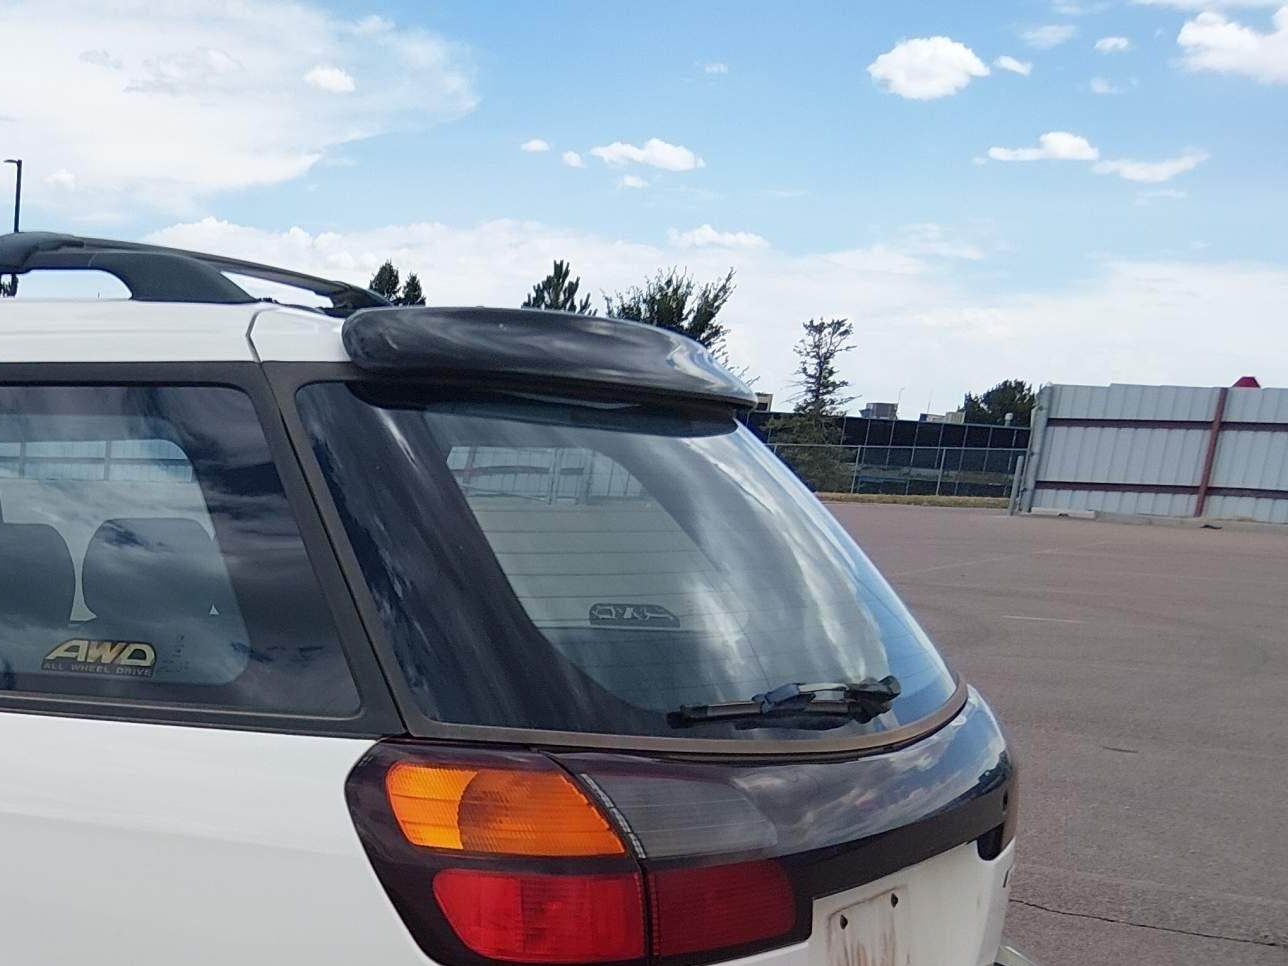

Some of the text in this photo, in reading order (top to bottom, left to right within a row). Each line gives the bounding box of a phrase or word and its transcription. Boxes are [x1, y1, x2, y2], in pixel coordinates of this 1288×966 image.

[44, 639, 156, 667] AWD
[42, 662, 153, 677] ALL WHEEL DRIVE
